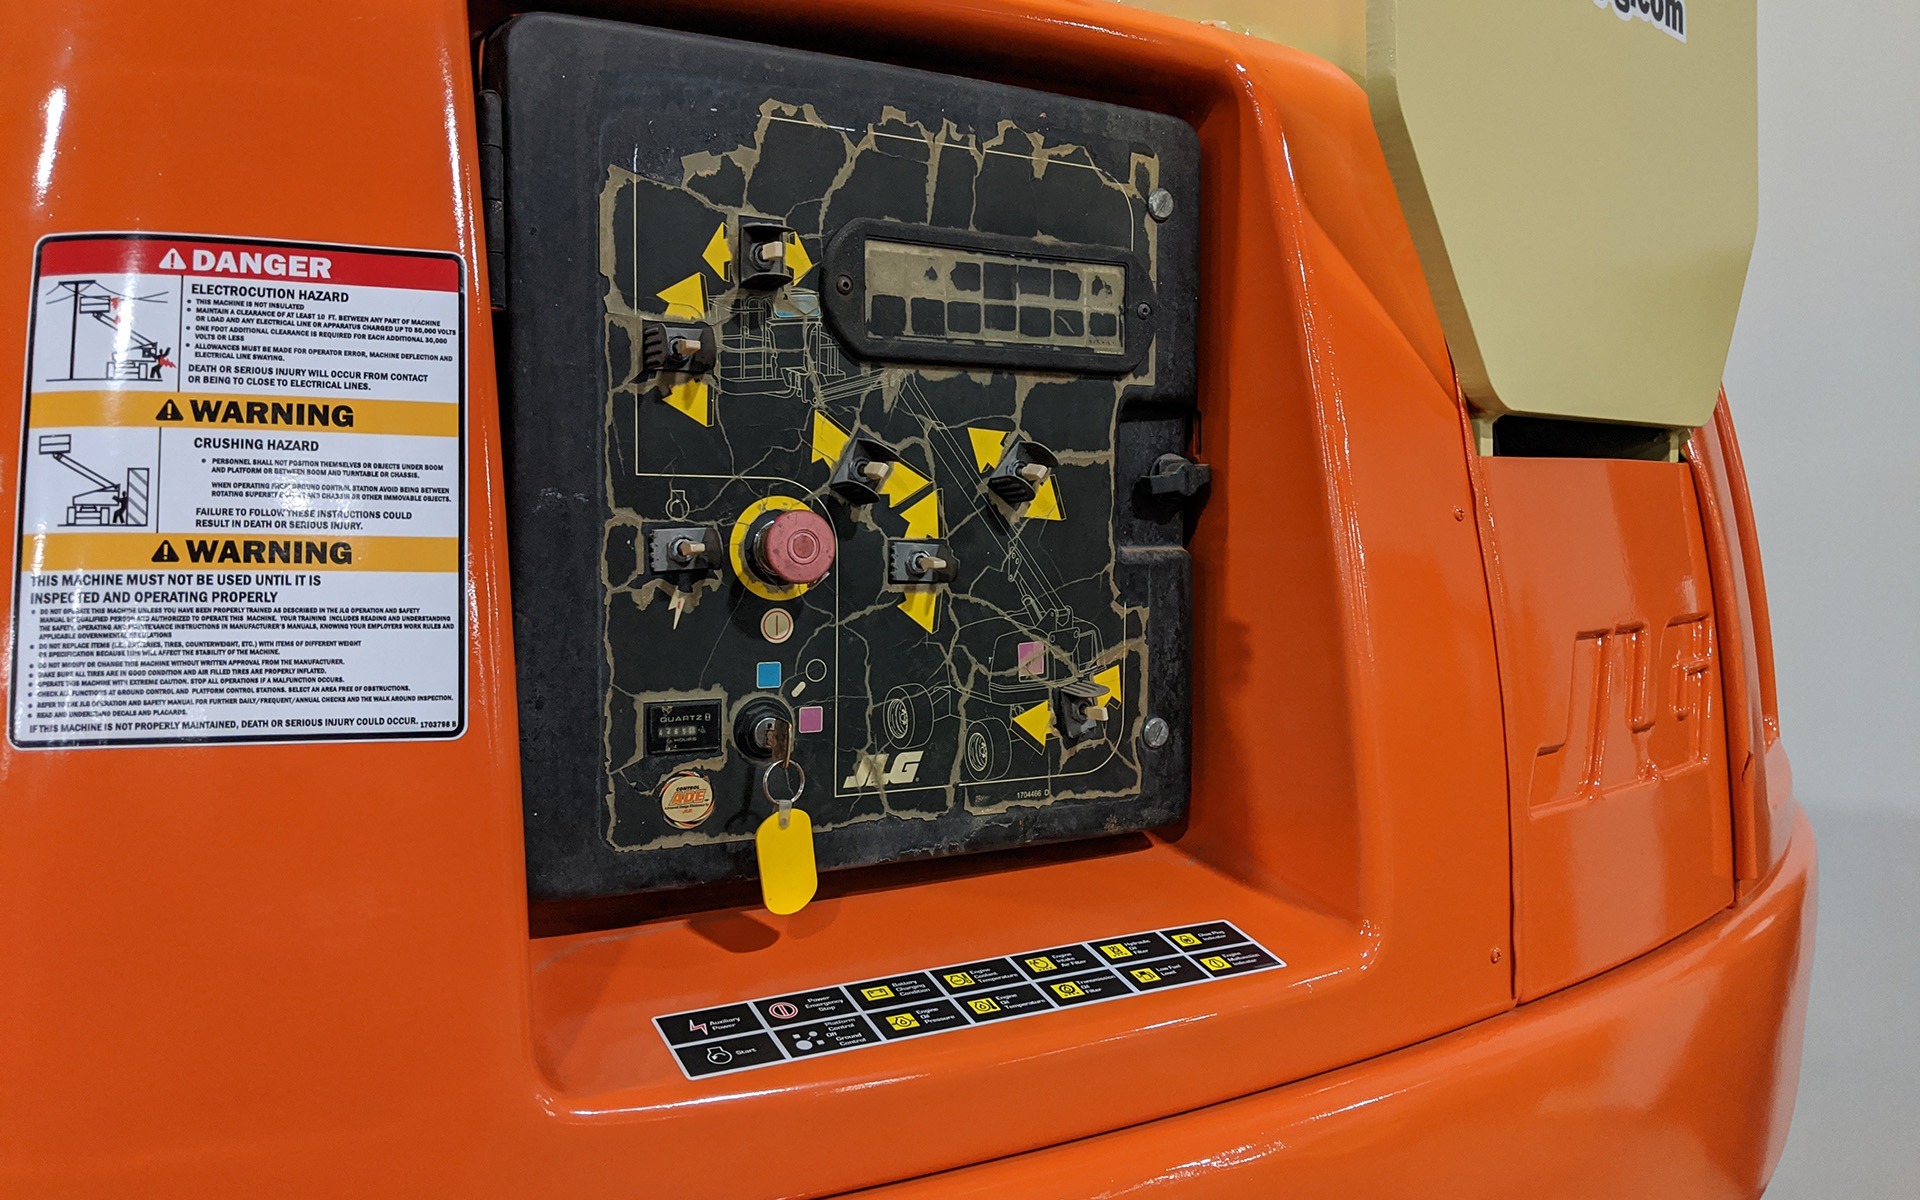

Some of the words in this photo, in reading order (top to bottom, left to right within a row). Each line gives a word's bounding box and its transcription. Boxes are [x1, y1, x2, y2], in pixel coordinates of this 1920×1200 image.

[193, 250, 332, 280] DANGER
[192, 284, 294, 300] ELECTROCUTION
[299, 289, 349, 302] HAZARD
[269, 302, 304, 310] INSULATED
[196, 307, 228, 315] MAINTAIN
[236, 309, 275, 318] CLEARANCE
[338, 315, 369, 323] BETWEEN
[256, 319, 294, 327] ELECTRICAL
[323, 322, 360, 331] APPARATUS
[362, 324, 393, 332] CHARGED
[195, 343, 240, 352] ALLOWANCES
[308, 349, 342, 357] OPERATOR
[401, 353, 438, 361] DEFLECTION
[189, 364, 216, 373] DEATH
[219, 365, 231, 374] OR
[234, 366, 273, 376] SERIOUS
[276, 368, 306, 377] INJURY
[308, 369, 328, 378] WILL
[331, 370, 361, 379] OCCUR
[364, 371, 388, 380] FROM
[390, 372, 428, 382] CONTACT
[188, 375, 200, 384] OR
[203, 376, 230, 385] BEING
[233, 377, 244, 386] TO
[246, 377, 275, 387] CLOSE
[277, 379, 288, 387] TO
[290, 379, 342, 389] ELECTRICAL
[344, 382, 371, 390] LINES.
[190, 400, 354, 428] WARNING
[194, 437, 263, 450] CRUSHING
[268, 440, 319, 451] HAZARD
[196, 508, 233, 516] FAILURE
[236, 508, 247, 516] TO
[249, 509, 288, 517] FOLLOW
[288, 509, 314, 518] THESE
[318, 510, 381, 519] INSTRUCTIONS
[196, 519, 229, 528] RESULT
[232, 520, 241, 528] IN
[244, 520, 272, 529] DEATH
[274, 520, 287, 529] OR
[289, 521, 328, 530] SERIOUS
[331, 522, 363, 530] INJURY.
[186, 540, 352, 565] WARNING
[31, 574, 58, 587] THIS
[62, 574, 123, 586] MACHINE
[127, 574, 164, 586] MUST
[168, 574, 193, 586] NOT
[197, 574, 213, 586] BE
[217, 574, 252, 586] USED
[256, 574, 292, 586] UNTIL
[295, 574, 306, 586] IT
[309, 574, 321, 586] IS
[31, 592, 100, 605] INSPECTED
[103, 592, 130, 604] AND
[135, 592, 207, 604] OPERATING
[212, 592, 277, 603] PROPERLY
[660, 714, 702, 723] QUARTZ
[1528, 613, 1713, 820] JLG
[30, 725, 36, 734] IF
[40, 724, 58, 733] THIS
[61, 723, 100, 733] MACHINE
[105, 723, 112, 732] IS
[116, 723, 132, 731] NOT
[135, 722, 179, 731] PROPERLY
[182, 721, 238, 730] MAINTAINED,
[241, 720, 268, 729] DEATH
[271, 720, 283, 728] OR
[285, 719, 323, 728] SERIOUS
[325, 718, 354, 727] INJURY
[356, 718, 385, 726] COULD
[387, 717, 418, 726] OCCUR.
[843, 751, 924, 788] JLG
[668, 789, 706, 806] ADE
[974, 971, 998, 979] Coolant
[978, 973, 1018, 984] Temperature
[1075, 974, 1116, 985] Transmission
[896, 984, 926, 992] Charging
[900, 988, 930, 996] Condition
[805, 999, 844, 1009] Emergency
[1004, 999, 1045, 1010] Temperature
[710, 1016, 740, 1026] Auxiliary
[824, 1018, 856, 1027] Platform
[924, 1015, 955, 1024] Pressure
[836, 1033, 862, 1042] Ground
[839, 1038, 866, 1046] Control
